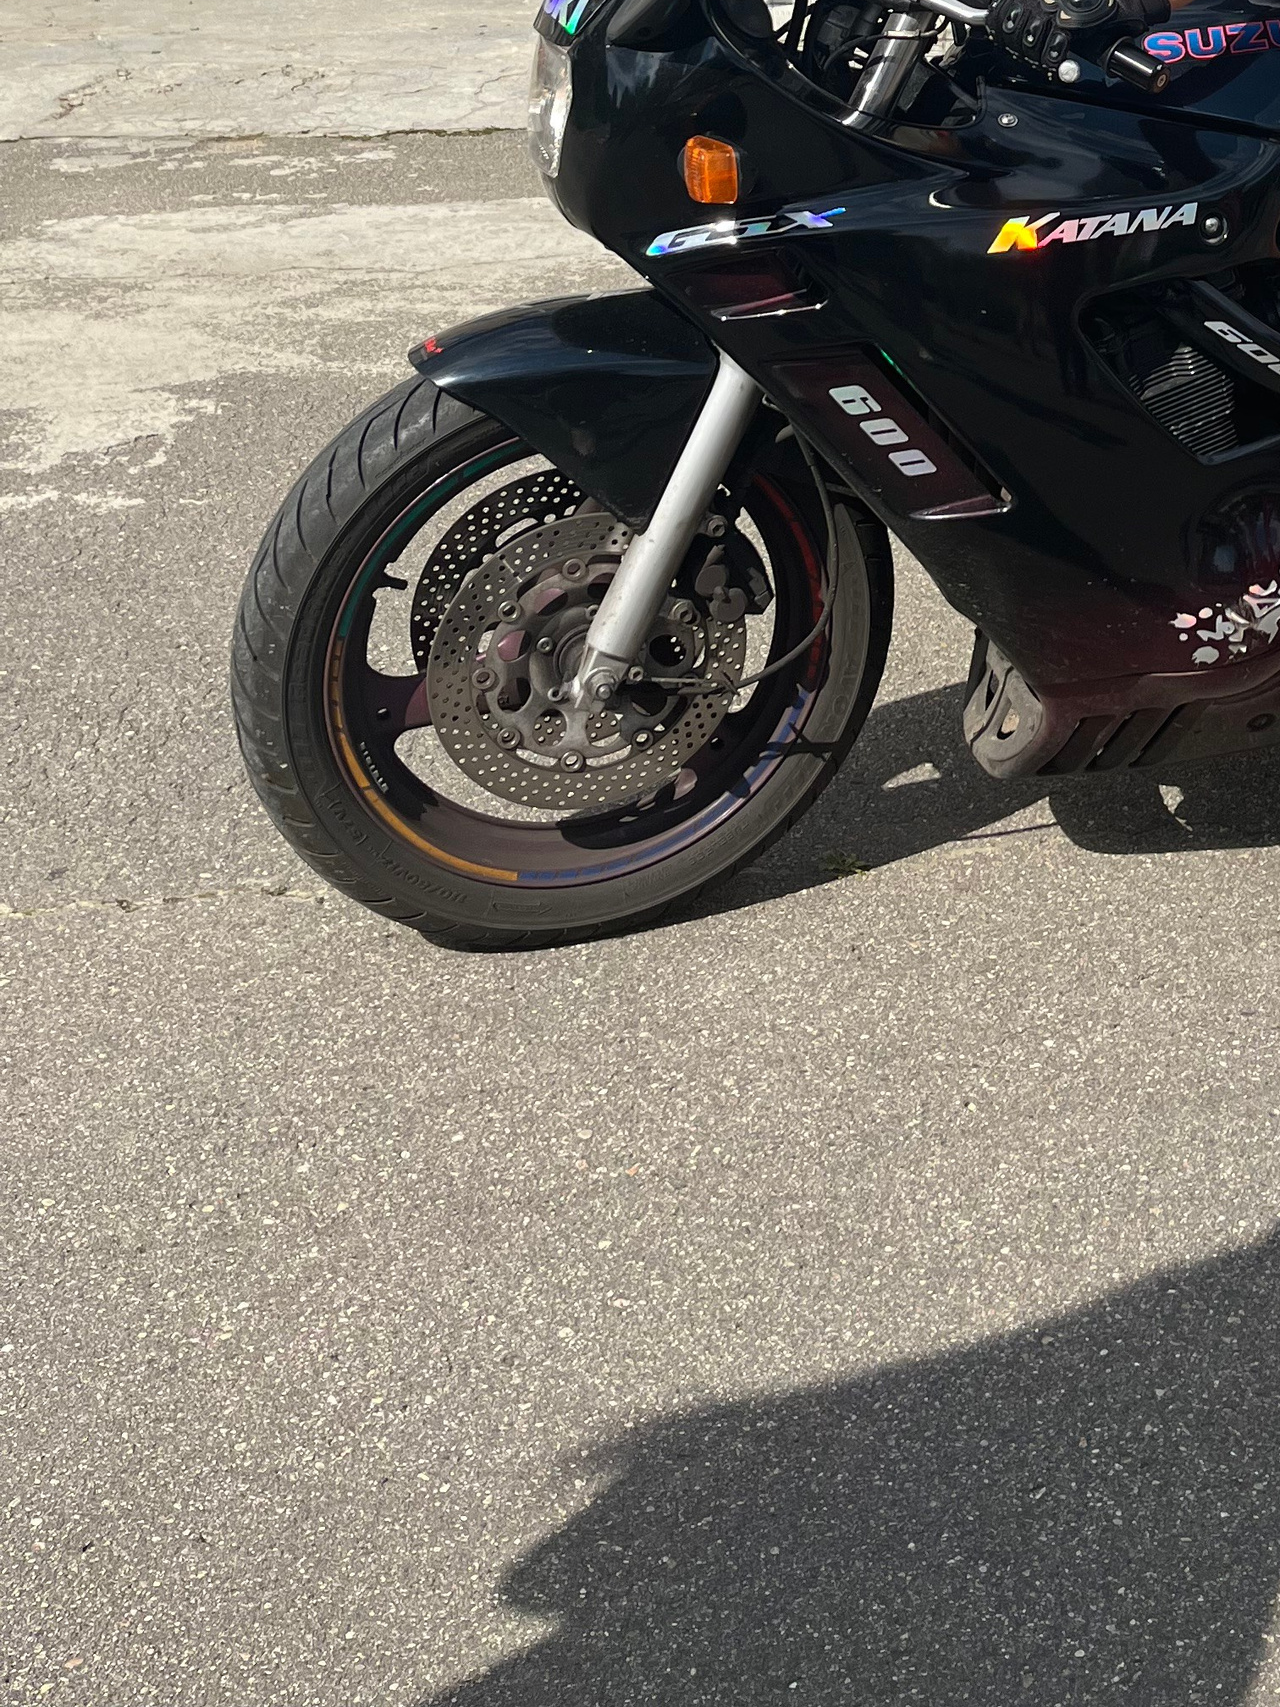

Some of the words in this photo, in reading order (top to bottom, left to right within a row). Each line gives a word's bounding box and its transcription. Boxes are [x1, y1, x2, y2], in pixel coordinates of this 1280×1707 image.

[646, 207, 847, 256] GSX
[987, 201, 1199, 254] KATANA
[828, 384, 938, 477] 600
